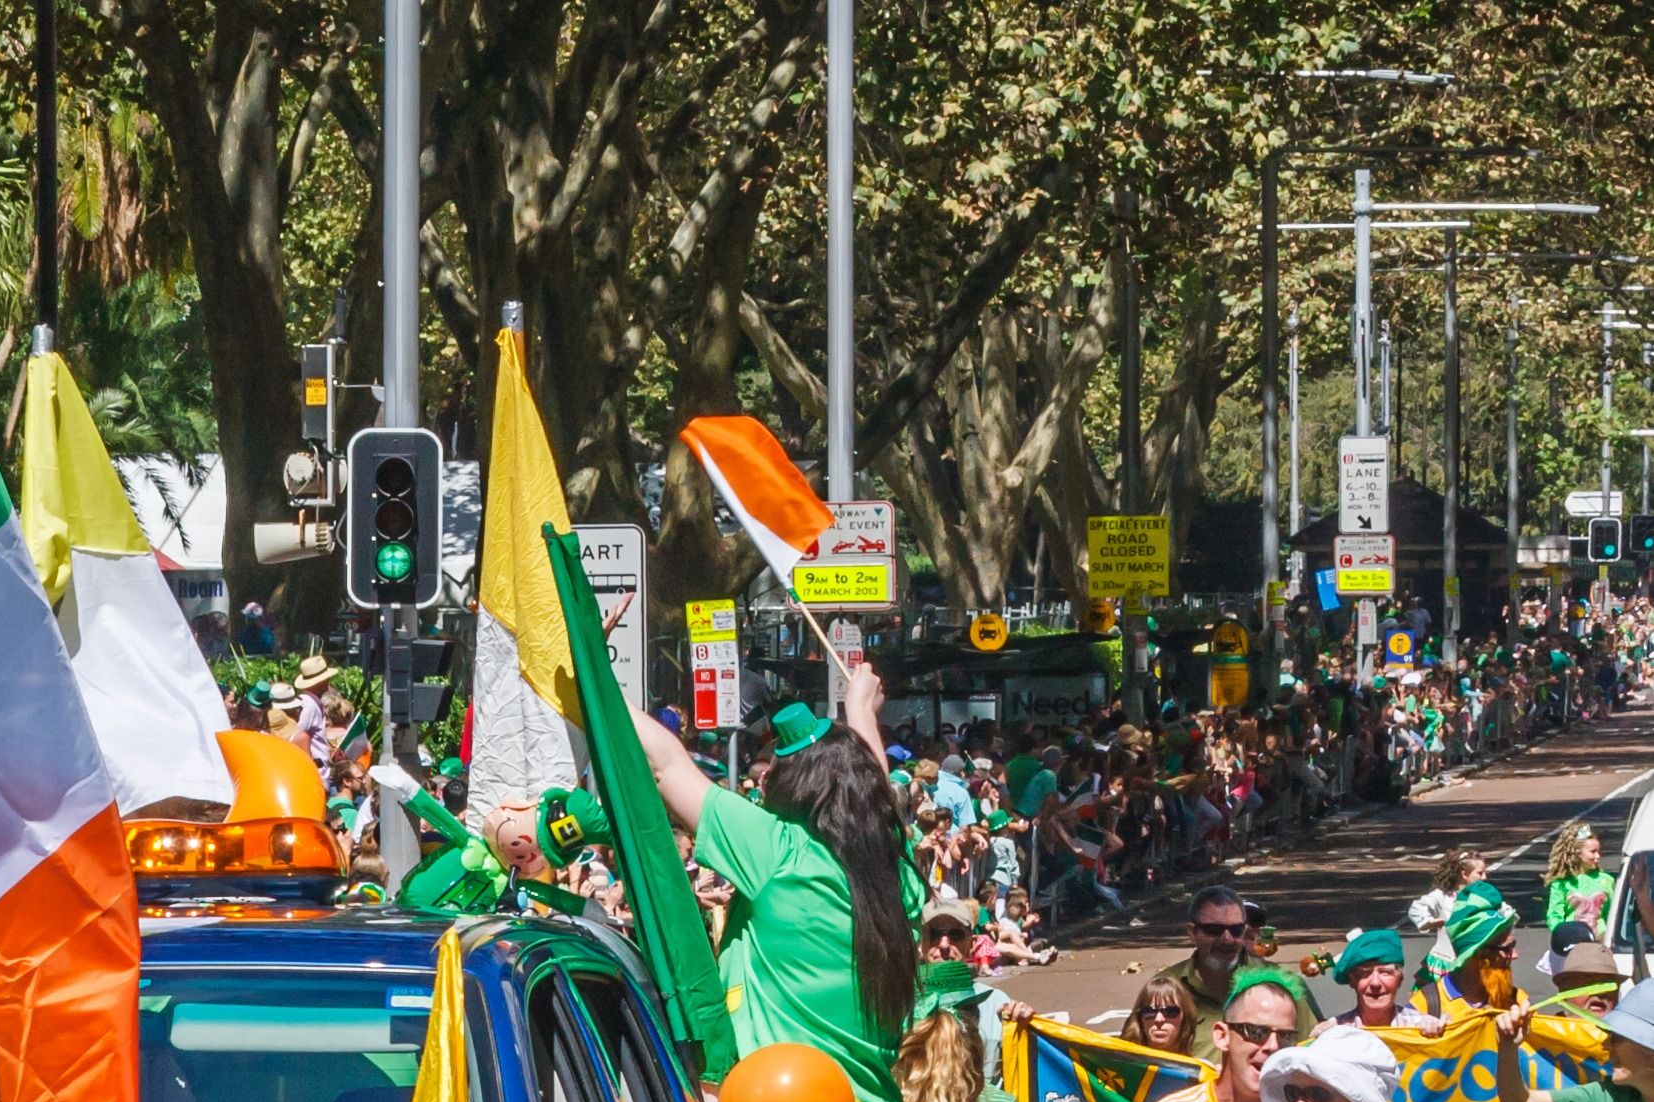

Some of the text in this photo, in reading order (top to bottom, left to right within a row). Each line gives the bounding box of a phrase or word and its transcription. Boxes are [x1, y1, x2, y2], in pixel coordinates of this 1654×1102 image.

[1346, 468, 1381, 478] LANE
[833, 510, 867, 518] ARWAY
[849, 520, 886, 530] EVENT
[1089, 519, 1166, 531] SPECIAL EVENT
[1107, 533, 1148, 544] ROAD
[579, 544, 624, 560] ART
[1100, 545, 1156, 557] CLOSED
[1092, 562, 1164, 573] SUN 17 MARCH
[805, 572, 879, 584] 9AM to 2PM
[814, 587, 850, 596] MARCH
[855, 587, 879, 596] 2013
[1012, 689, 1091, 716] Need
